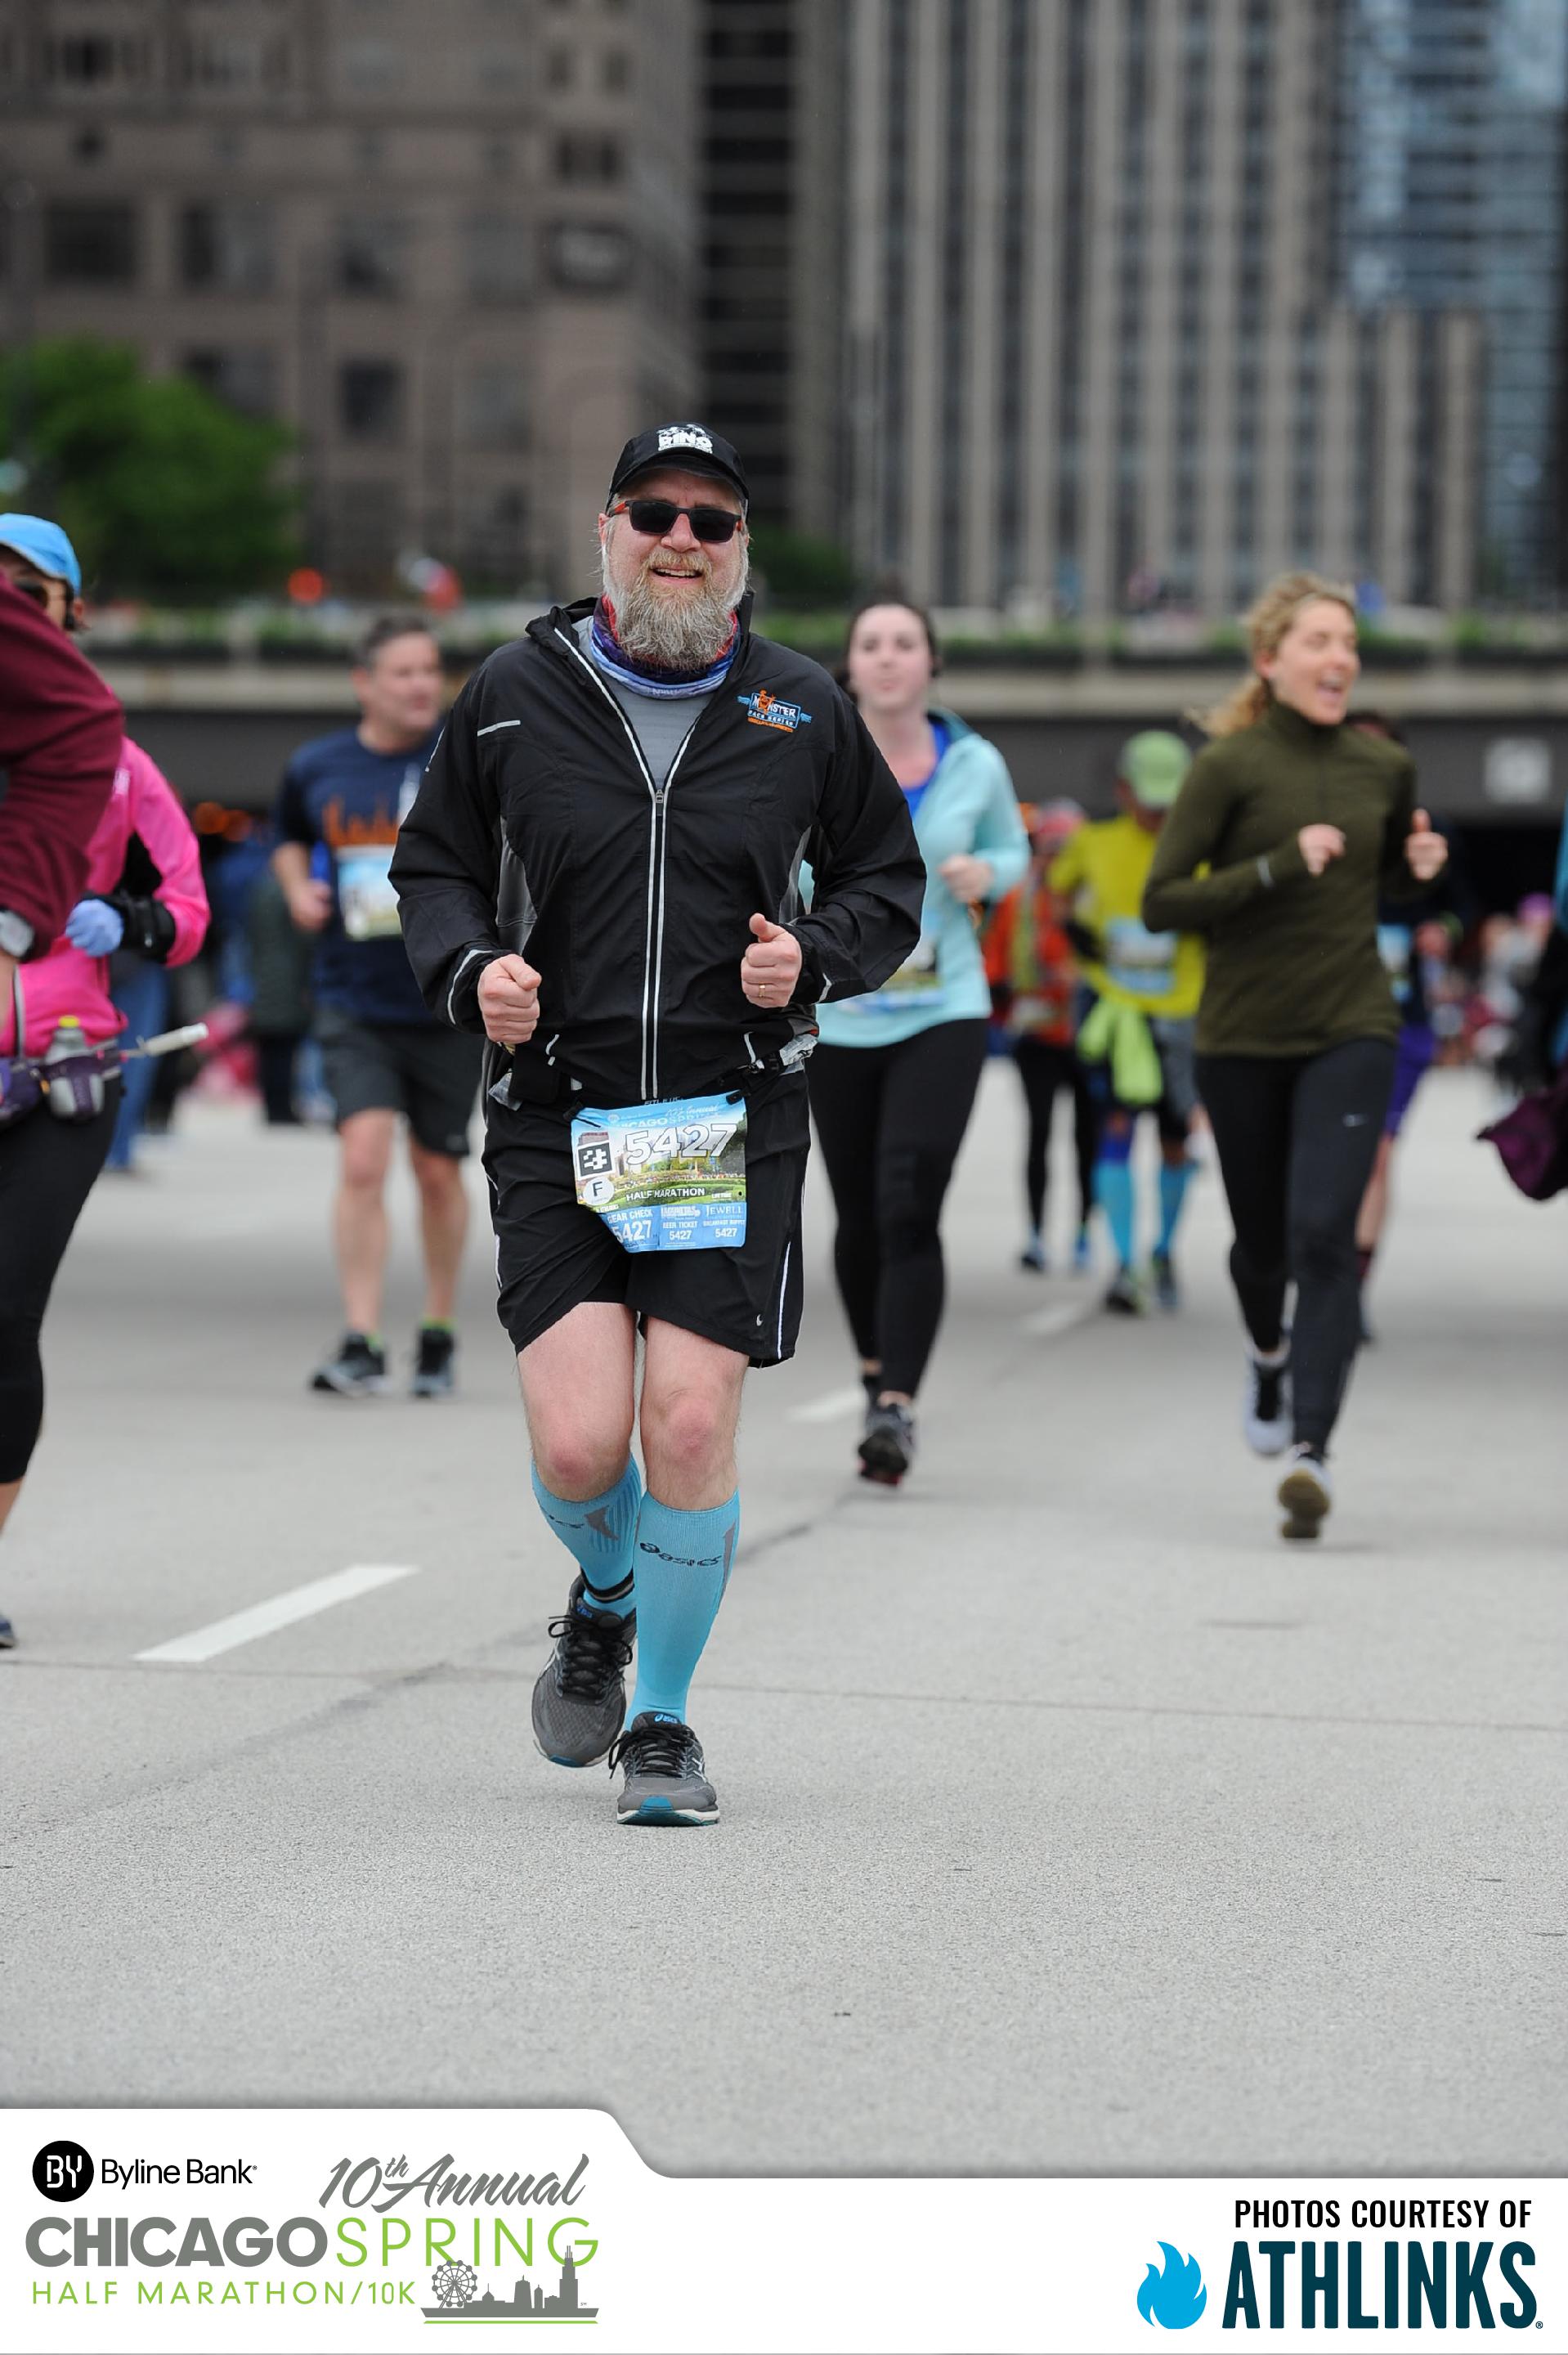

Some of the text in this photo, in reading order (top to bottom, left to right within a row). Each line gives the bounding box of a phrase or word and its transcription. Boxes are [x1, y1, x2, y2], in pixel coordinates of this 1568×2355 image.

[752, 695, 796, 718] MNSTER
[625, 1124, 737, 1165] 5427
[593, 1182, 603, 1196] F
[626, 1191, 652, 1201] HALF
[654, 1188, 705, 1198] MARATHON
[611, 1220, 652, 1243] 5427
[669, 1230, 692, 1240] 5427
[715, 1228, 738, 1237] 5427
